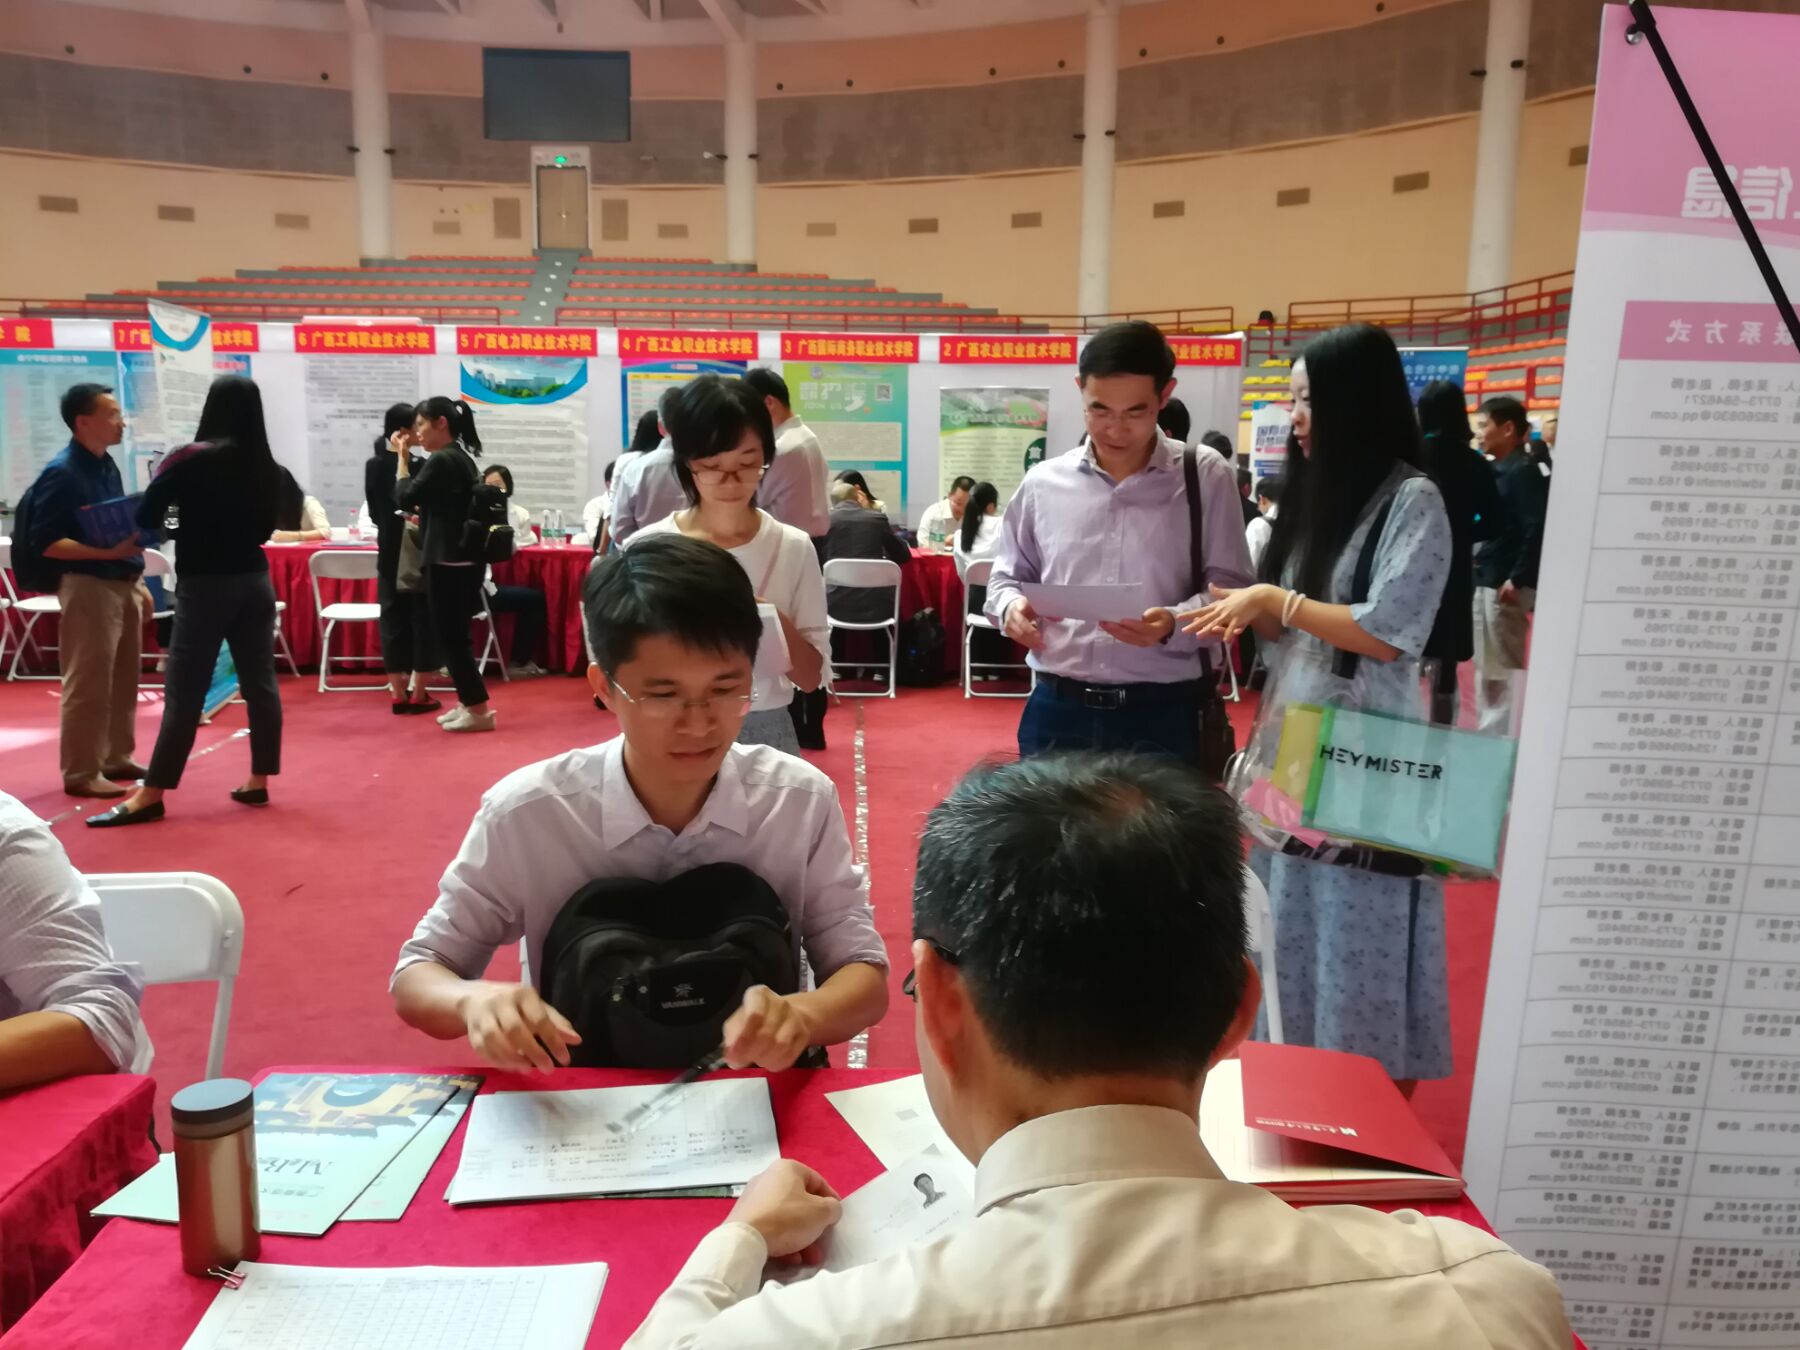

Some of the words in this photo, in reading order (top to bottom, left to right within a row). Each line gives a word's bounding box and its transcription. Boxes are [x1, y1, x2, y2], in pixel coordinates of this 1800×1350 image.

[298, 332, 307, 348] 6
[311, 330, 430, 349] 广西工商职业技术学院
[460, 334, 469, 348] 5
[473, 332, 592, 351] 广西电力职业技术学院
[622, 336, 631, 350] 4
[635, 336, 753, 354] 广西工业职业技术学院
[784, 339, 792, 354] 3
[797, 338, 913, 357] 广西国际商务职业技术学院
[943, 342, 952, 356] 2
[956, 341, 1072, 359] 广西农业职业技术学院
